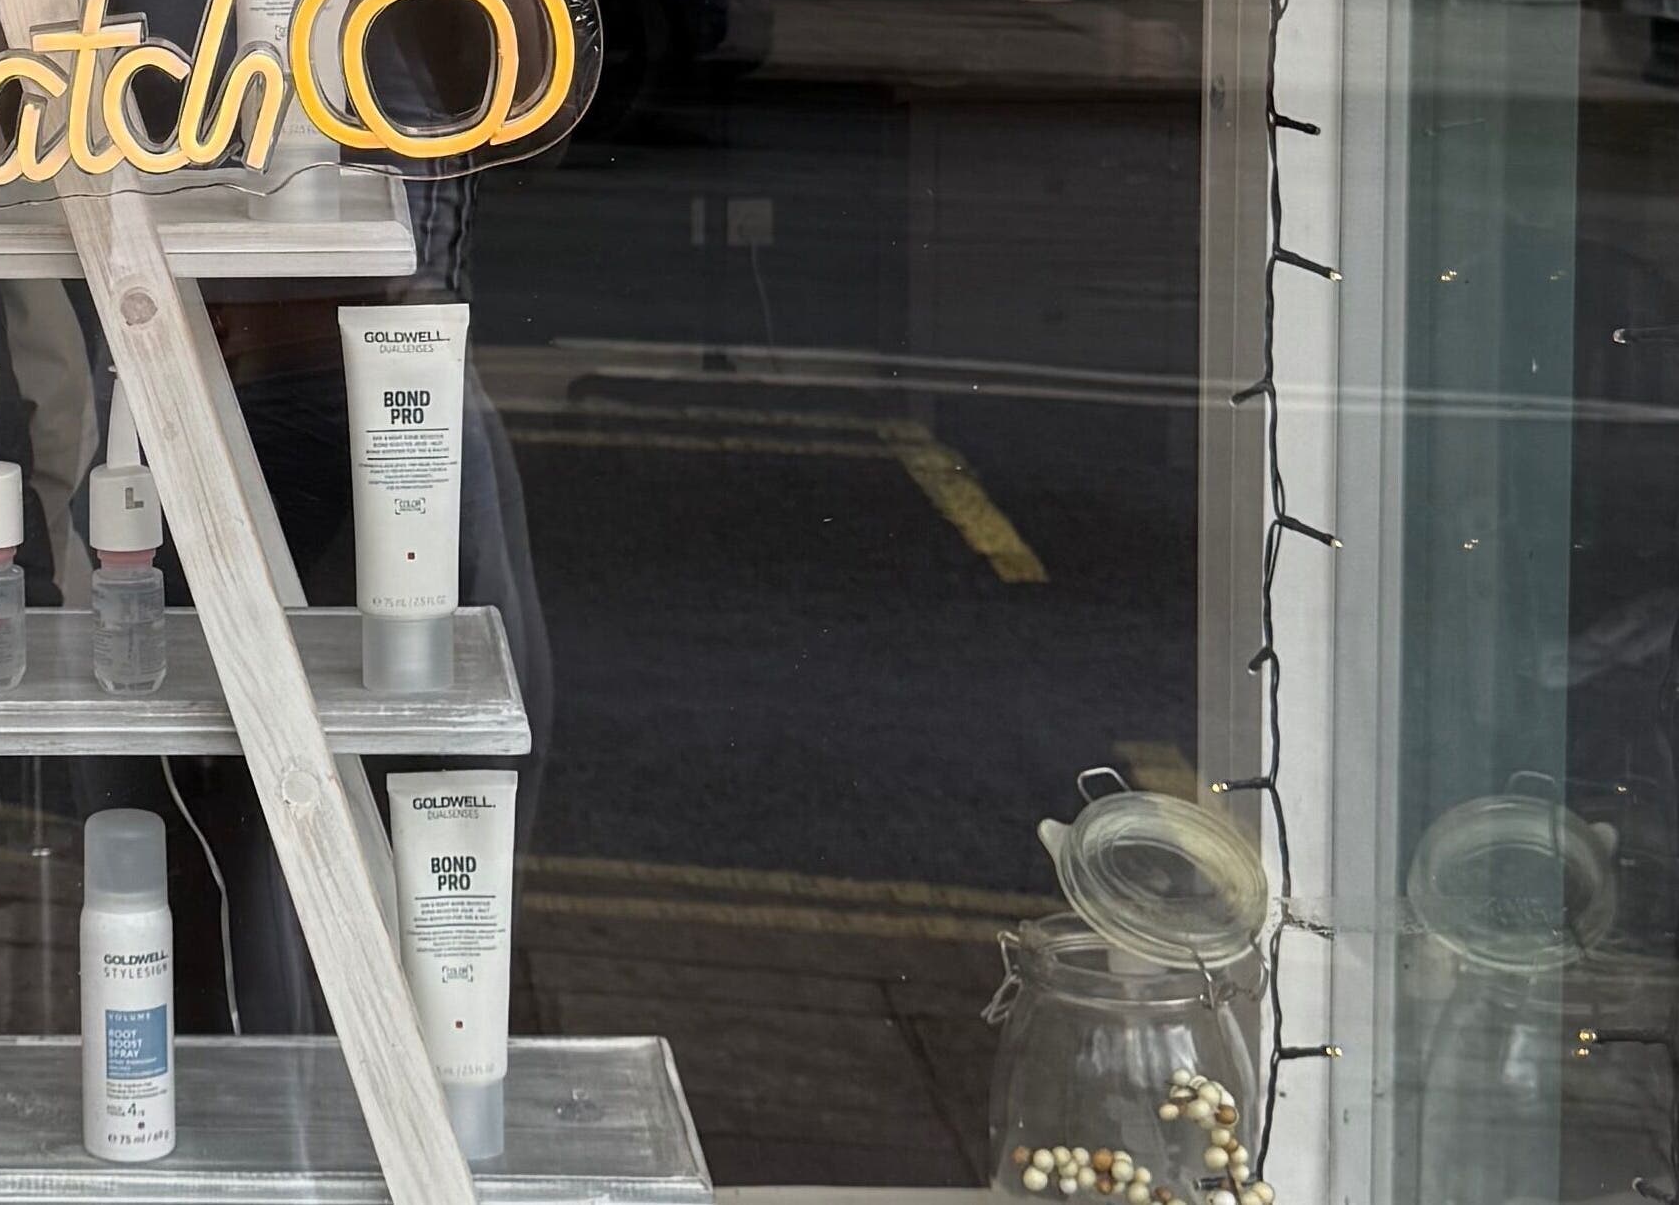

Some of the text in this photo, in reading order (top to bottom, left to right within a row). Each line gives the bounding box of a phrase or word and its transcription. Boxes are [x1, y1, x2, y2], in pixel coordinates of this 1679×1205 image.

[364, 329, 450, 343] GOLDWELL
[383, 390, 431, 408] BOND
[390, 407, 425, 425] PRO
[430, 855, 477, 873] BOND
[437, 873, 471, 891] PRO
[103, 950, 169, 965] GOLDWELL
[103, 963, 168, 979] STYLESIGN
[107, 1012, 151, 1022] VOLUME
[108, 1029, 137, 1039] ROOT
[108, 1038, 143, 1049] BOOST
[108, 1048, 139, 1059] SPRAY
